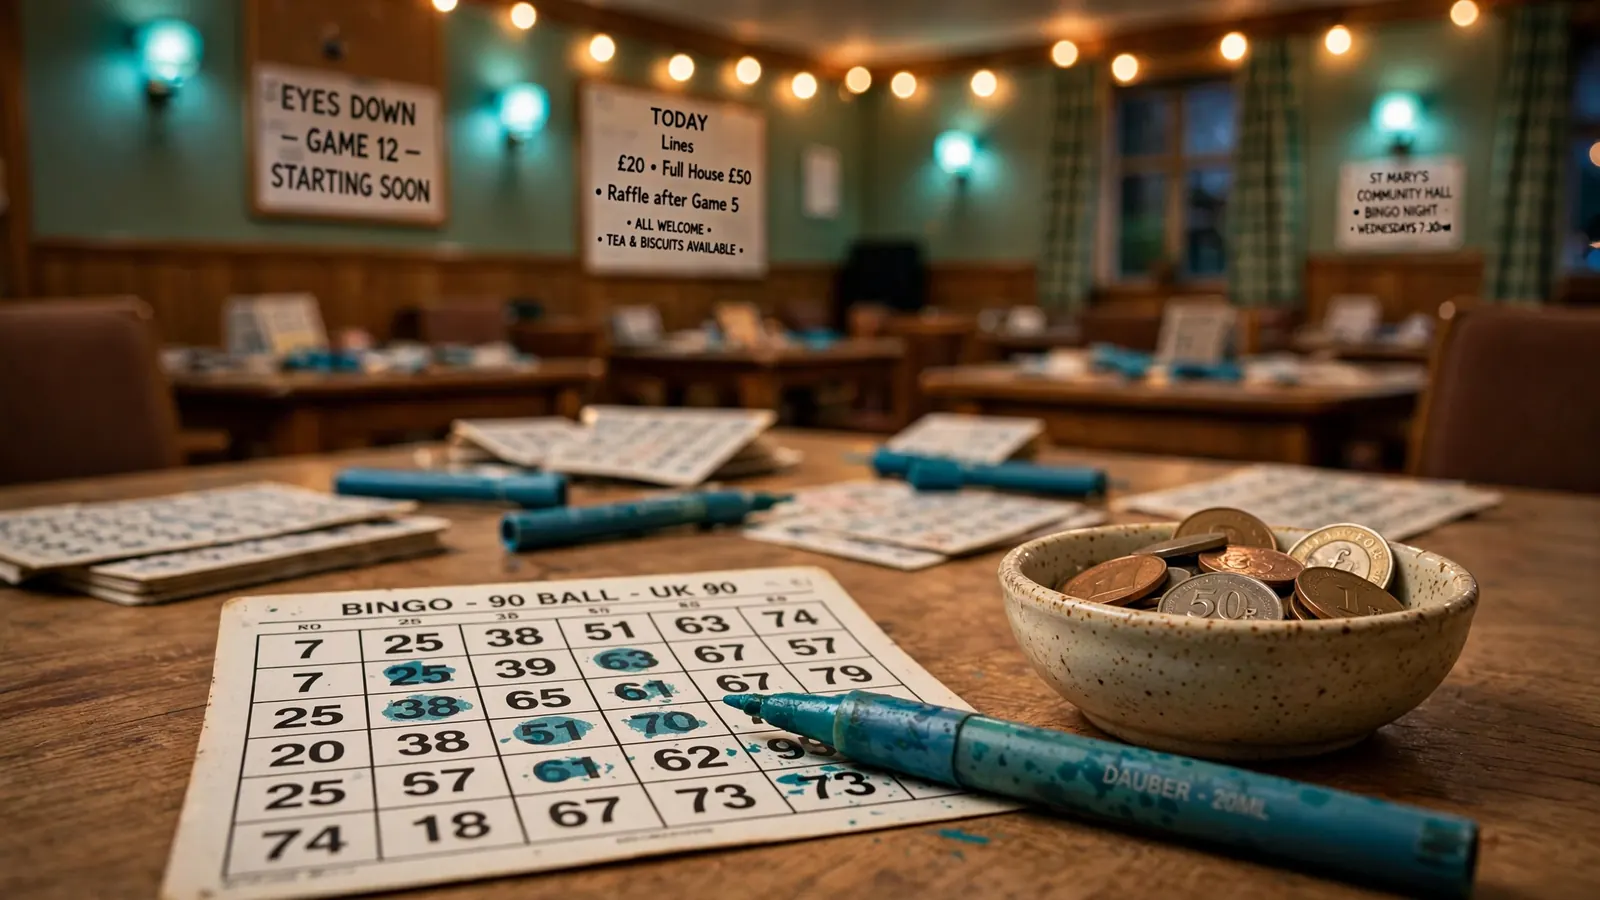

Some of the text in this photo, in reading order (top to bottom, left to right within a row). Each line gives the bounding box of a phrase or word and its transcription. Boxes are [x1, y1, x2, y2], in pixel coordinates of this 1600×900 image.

[281, 83, 416, 126] EYES DOWN
[650, 107, 708, 131] TODAY
[306, 127, 369, 159] GAME
[376, 136, 399, 163] 12
[661, 134, 694, 153] Lines
[271, 162, 430, 203] STARTING SOON
[617, 154, 752, 185] £20 Full House £50
[1370, 170, 1429, 184] ST MARY'S
[607, 184, 740, 213] Raffle after Game 5
[1357, 185, 1453, 202] COMMUNITY HALL
[1365, 203, 1438, 219] BINGO NIGHT
[635, 217, 704, 235] ALL WELCOME
[1357, 222, 1417, 234] WEDNESDAYS
[606, 233, 736, 256] TEA & BISCUITS AVAILABLE
[341, 598, 453, 616] BINGO
[488, 594, 525, 608] 90
[537, 589, 619, 605] BALL
[649, 584, 695, 598] UK
[702, 581, 738, 595] 90
[294, 609, 818, 659] 7 25 38 51 63 74
[293, 637, 836, 693] 7 25 39 63 67 57
[273, 665, 873, 730] 25 38 65 61 67 79
[269, 710, 700, 768] 20 38 51 70
[264, 779, 346, 812] 25
[533, 756, 601, 783] 61
[653, 745, 728, 772] 62
[1102, 763, 1191, 802] DAUBER
[1211, 788, 1270, 821] 20ML
[261, 770, 877, 863] 74 18 67 73 73
